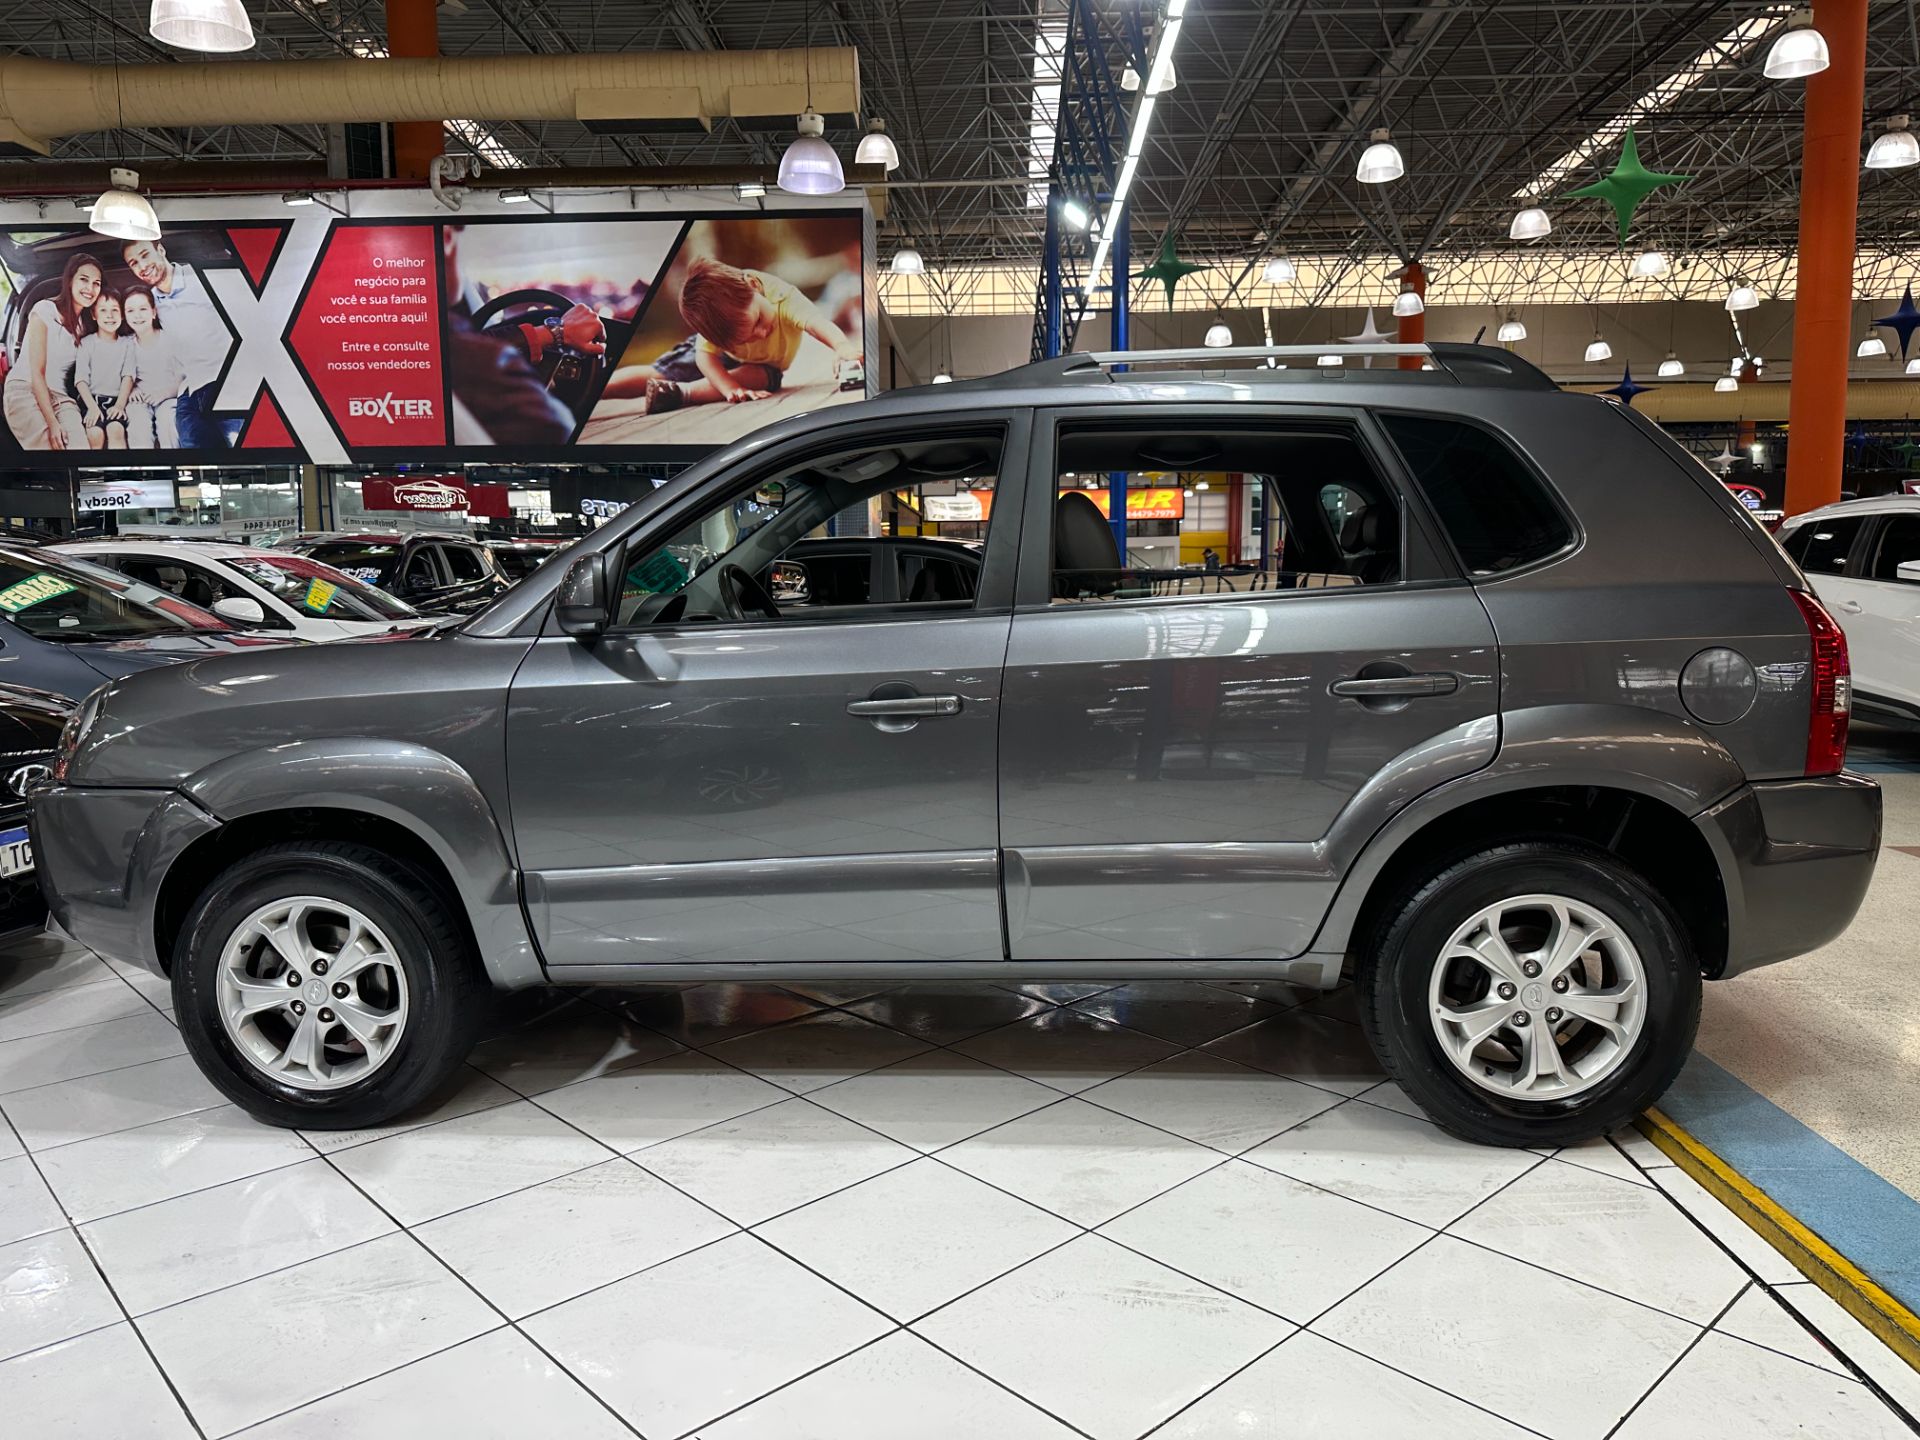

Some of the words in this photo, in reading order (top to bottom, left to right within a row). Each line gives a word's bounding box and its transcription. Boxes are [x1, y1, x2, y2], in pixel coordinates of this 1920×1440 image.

[373, 257, 383, 268] O
[386, 257, 425, 268] melhor
[354, 276, 399, 289] negócio
[402, 277, 426, 288] para
[330, 294, 357, 305] você
[369, 296, 388, 304] sua
[390, 293, 427, 304] família
[320, 313, 346, 324] você
[349, 313, 398, 323] encontra
[400, 312, 428, 324] aqui!
[342, 341, 371, 352] Entre
[382, 341, 430, 351] consulte
[328, 362, 365, 370] nossos
[367, 359, 431, 370] vendedores
[349, 392, 433, 424] BOXTER
